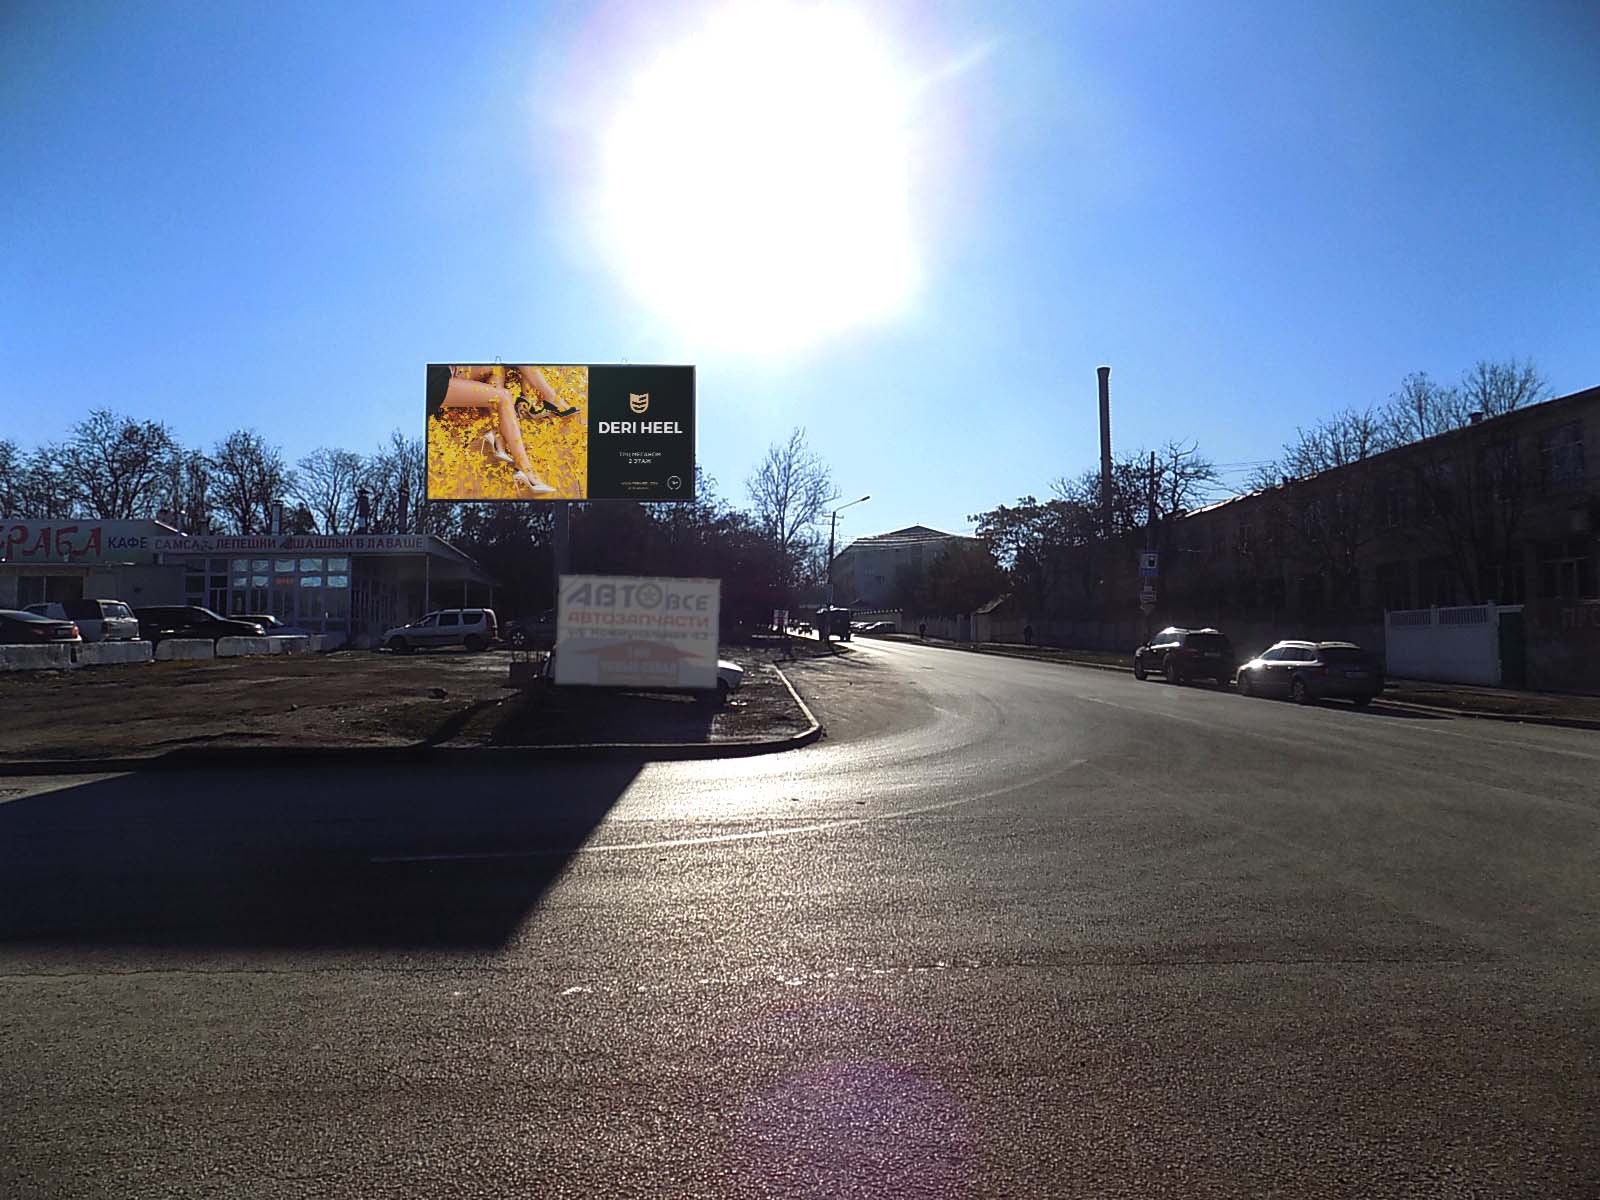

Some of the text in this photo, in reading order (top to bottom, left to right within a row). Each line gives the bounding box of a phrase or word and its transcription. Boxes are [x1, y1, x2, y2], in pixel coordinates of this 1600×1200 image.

[598, 421, 683, 434] DERI HEEL
[107, 536, 148, 550] КАФЕ
[154, 537, 424, 550] САМСА ЛЕПЕШКИ ШАШЛЫК В ЛАВАШЕ
[568, 610, 710, 628] АВТОЗАПЧАСТИ
